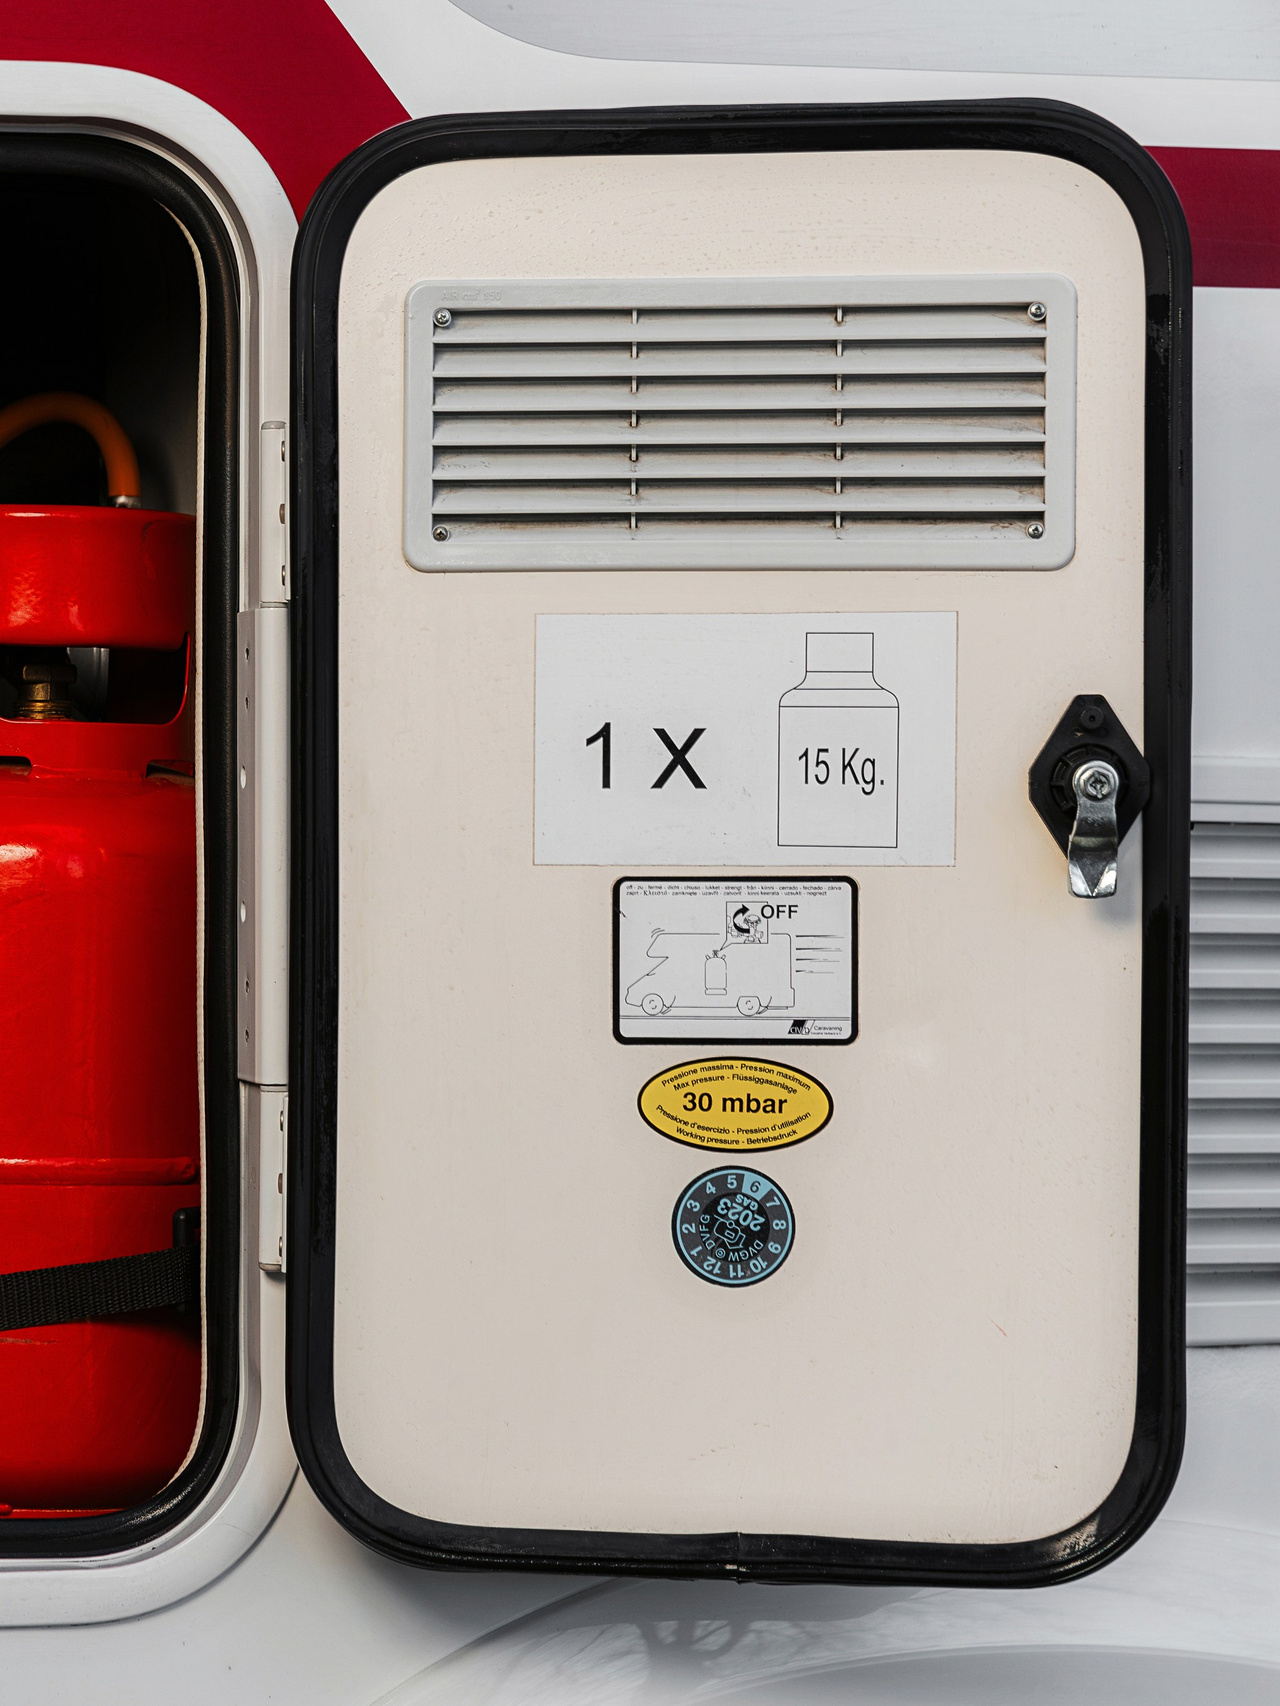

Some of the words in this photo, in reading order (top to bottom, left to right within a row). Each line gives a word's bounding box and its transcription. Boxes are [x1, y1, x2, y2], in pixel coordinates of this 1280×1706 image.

[586, 722, 611, 789] 1
[798, 747, 830, 785] 15
[841, 747, 885, 796] Kg.
[760, 904, 799, 919] OFF
[661, 1067, 698, 1087] Pressione
[700, 1064, 734, 1075] massima
[740, 1063, 775, 1075] Pression
[776, 1071, 811, 1091] maximum
[673, 1081, 689, 1092] Max
[691, 1075, 725, 1087] pressure
[732, 1073, 798, 1095] Flüssiggasanlage
[682, 1092, 713, 1112] 30
[722, 1093, 788, 1114] mbar
[656, 1104, 690, 1127] Pressione
[736, 1125, 770, 1135] Pression
[676, 1126, 706, 1143] Working
[706, 1135, 740, 1146] pressure
[746, 1128, 798, 1145] Betriebsdruck
[705, 1181, 717, 1194] 4
[726, 1175, 737, 1189] 5
[749, 1180, 762, 1194] 6
[686, 1199, 700, 1212] 3
[735, 1194, 758, 1211] GAS
[765, 1196, 780, 1207] 7
[717, 1198, 766, 1231] 2023
[681, 1222, 696, 1234] 2
[700, 1214, 716, 1250] DVFG
[772, 1219, 787, 1230] 8
[690, 1245, 703, 1257] 1
[728, 1240, 764, 1262] DVGW
[703, 1256, 721, 1274] 12
[728, 1264, 744, 1278] 11
[749, 1256, 768, 1273] 10
